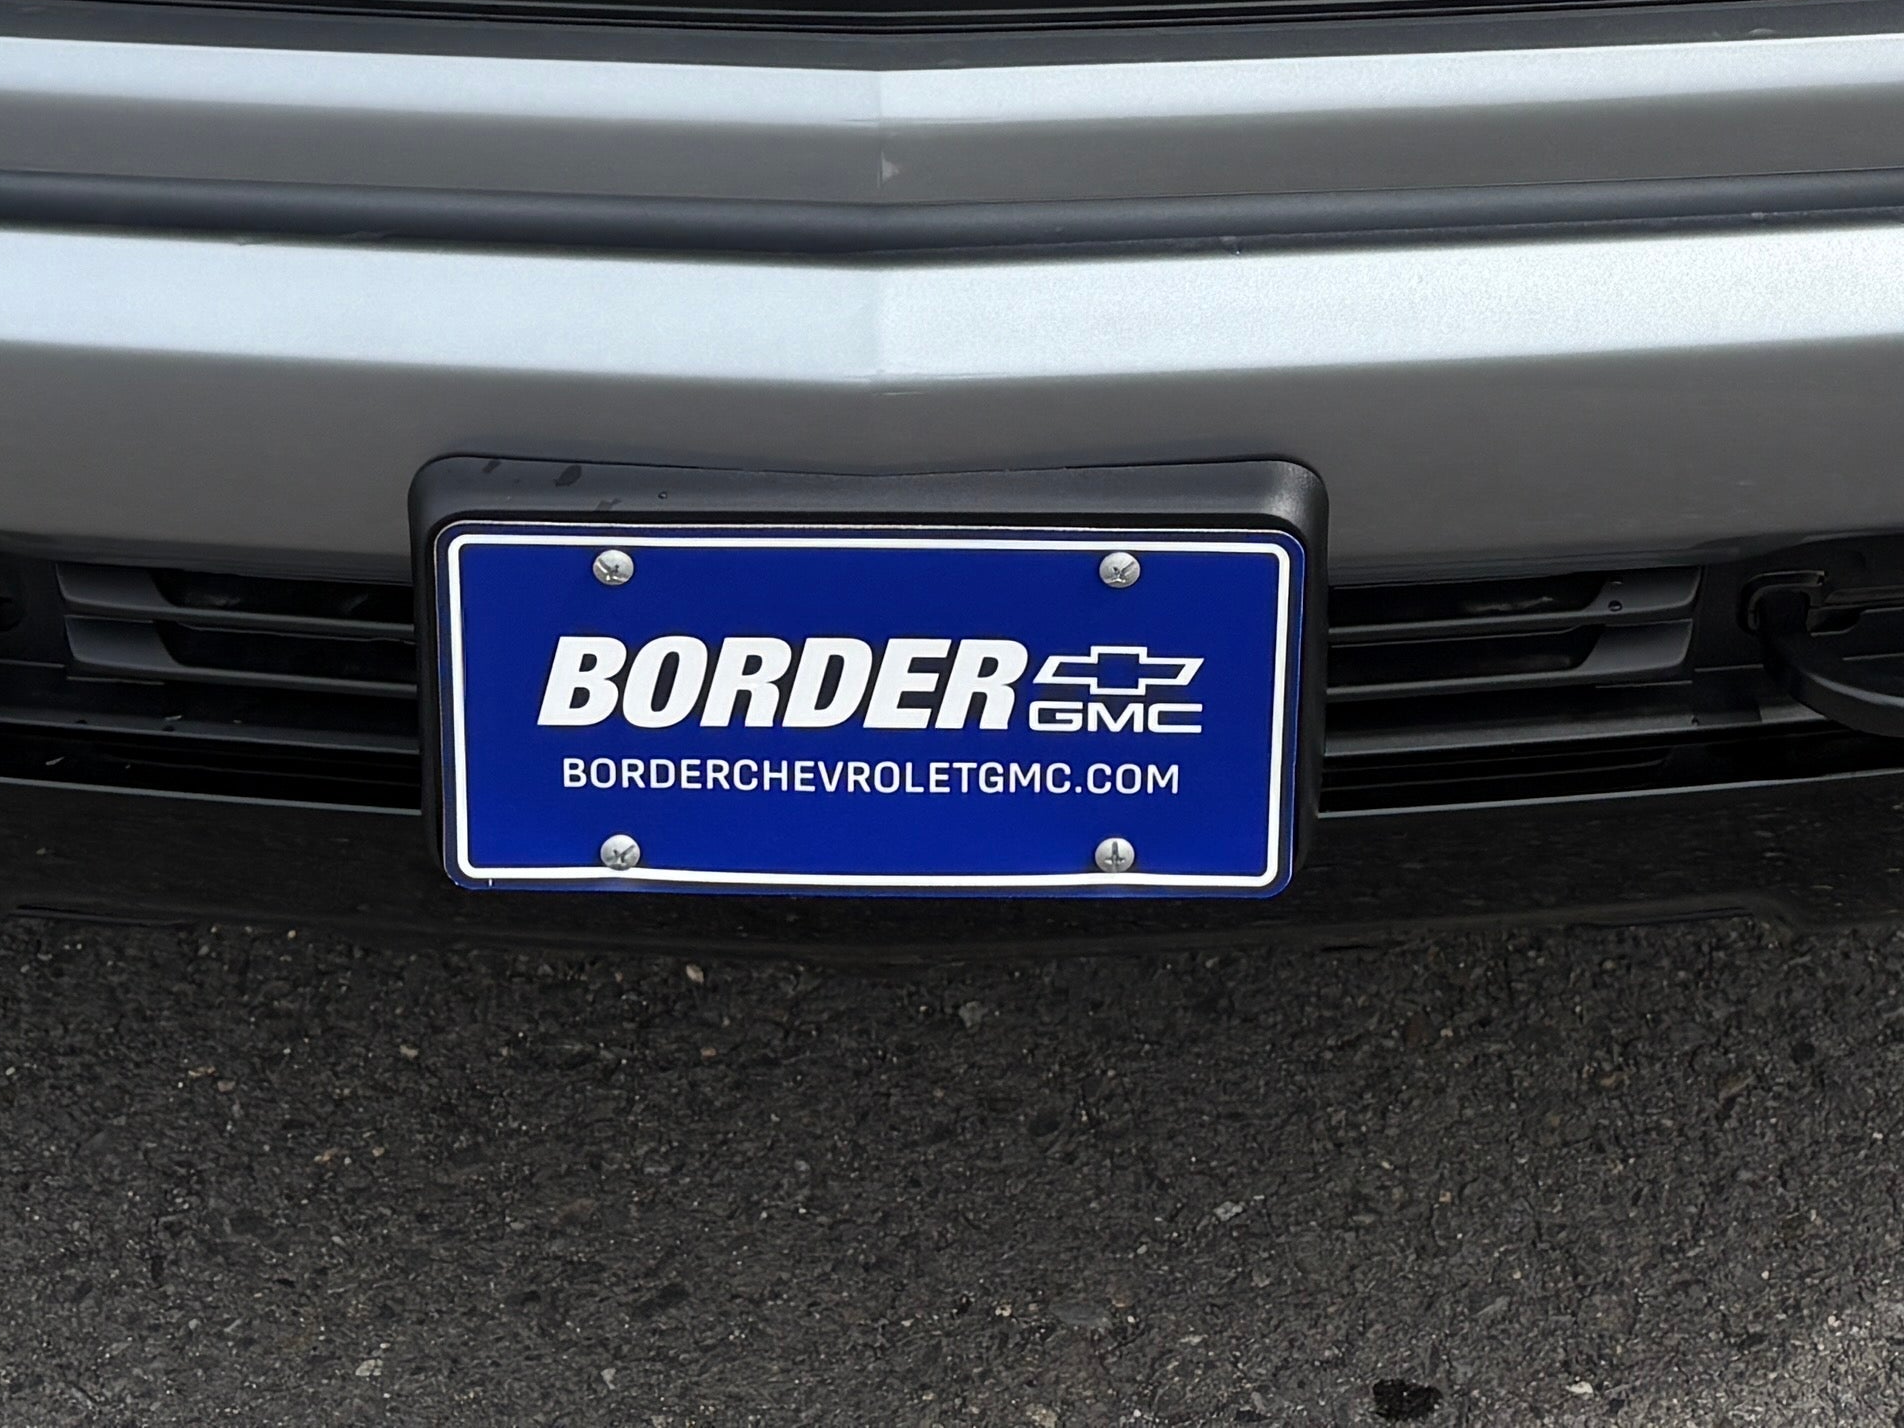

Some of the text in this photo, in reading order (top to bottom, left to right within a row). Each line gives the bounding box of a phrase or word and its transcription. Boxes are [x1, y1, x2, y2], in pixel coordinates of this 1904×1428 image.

[536, 635, 1204, 734] BORDER GMC
[563, 757, 1179, 794] BORDERCHEVROLETGMC.COM
